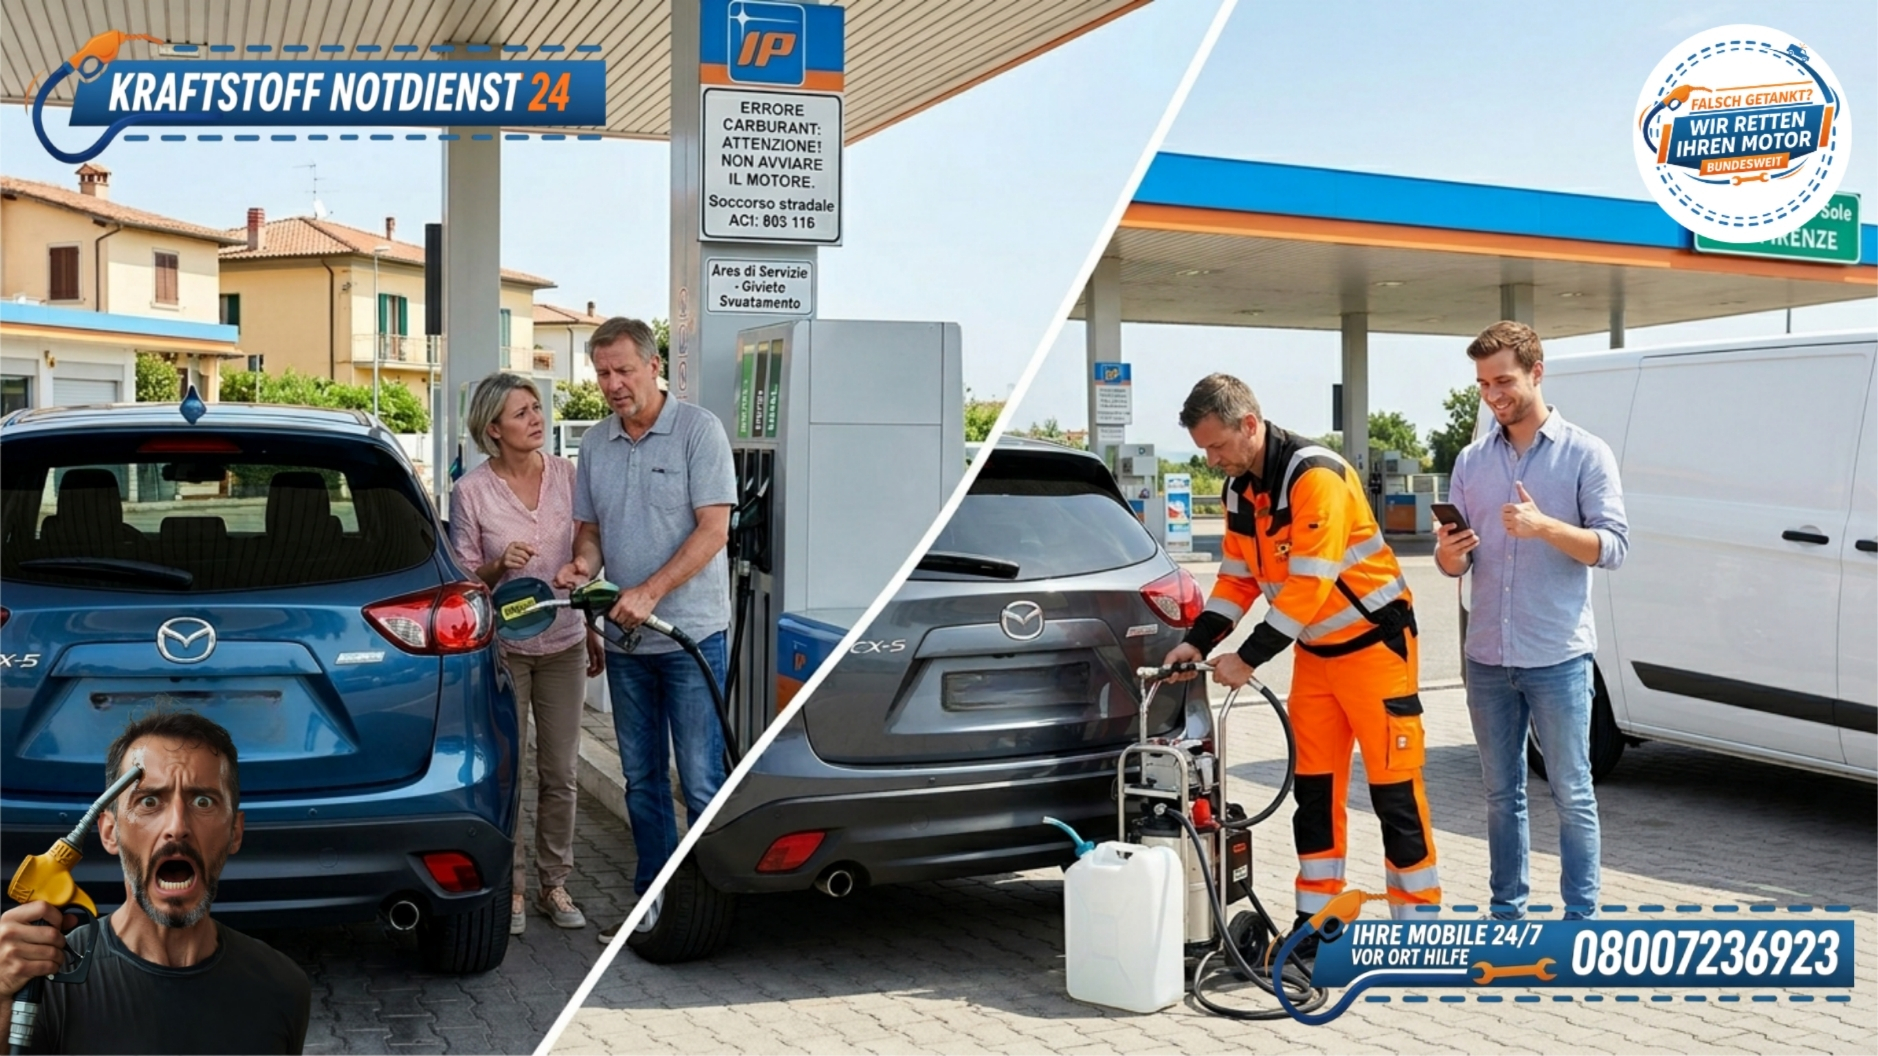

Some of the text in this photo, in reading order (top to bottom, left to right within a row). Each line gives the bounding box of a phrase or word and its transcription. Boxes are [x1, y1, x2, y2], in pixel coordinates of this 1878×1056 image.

[736, 31, 797, 67] IP
[741, 101, 805, 117] ERRORE
[723, 118, 821, 135] CARBURANT:
[722, 136, 822, 153] ATTENZIONE!
[721, 154, 823, 171] NON AVVIARE
[729, 173, 815, 189] IL MOTORE.
[709, 194, 835, 212] Soccorso stradale
[1820, 203, 1852, 222] Sole
[763, 214, 787, 228] 803
[792, 216, 815, 229] 116
[711, 263, 741, 277] Ares
[744, 265, 756, 277] di
[719, 295, 801, 309] Svuatamento
